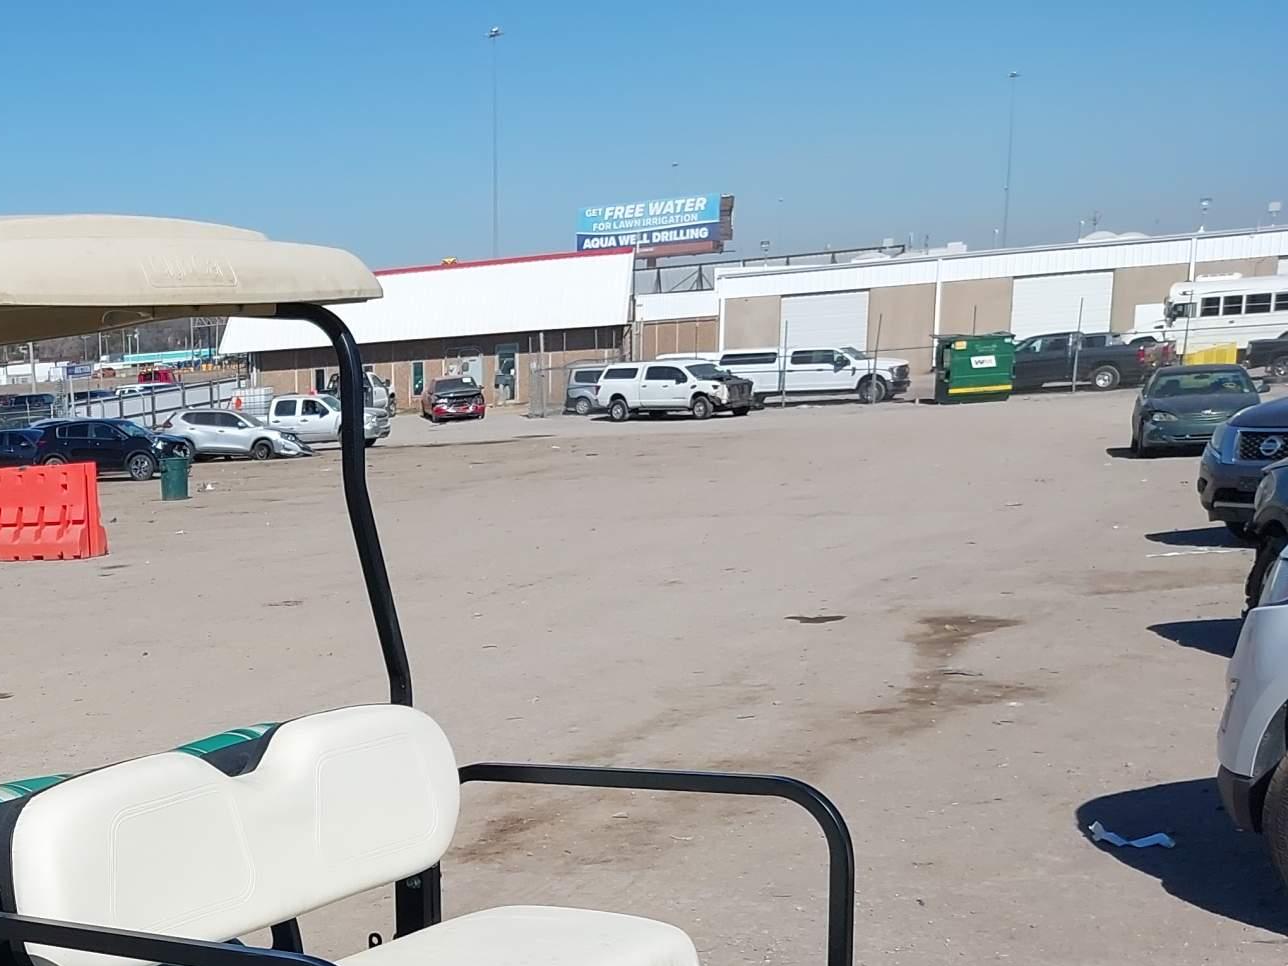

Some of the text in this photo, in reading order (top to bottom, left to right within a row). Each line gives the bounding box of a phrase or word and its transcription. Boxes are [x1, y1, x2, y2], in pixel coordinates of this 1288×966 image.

[585, 198, 706, 220] GET FREE WATER
[592, 214, 698, 231] FOR LAWN IRRIGATION
[582, 236, 616, 249] AQUA
[652, 227, 709, 242] DRILLING
